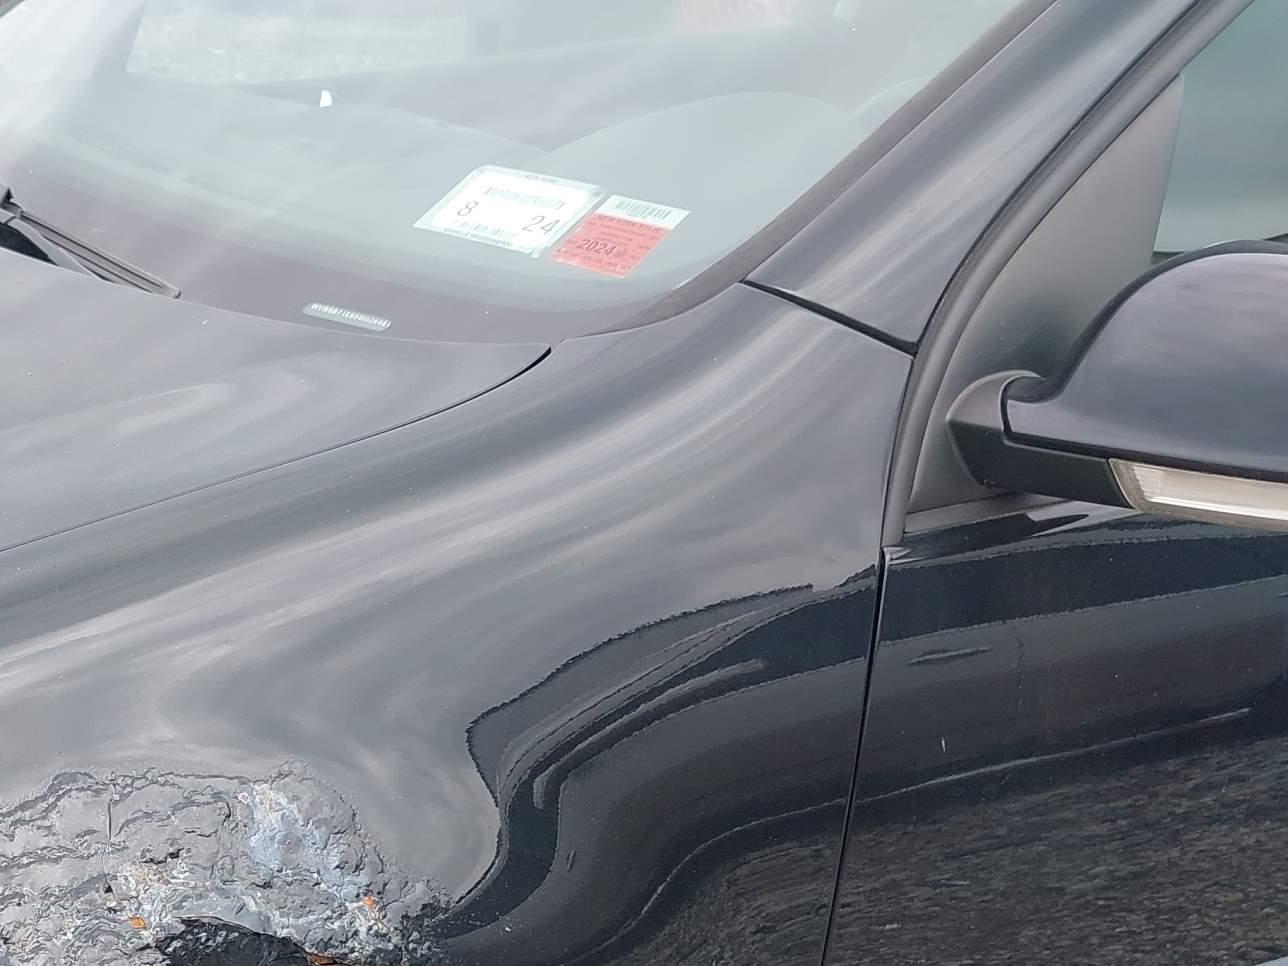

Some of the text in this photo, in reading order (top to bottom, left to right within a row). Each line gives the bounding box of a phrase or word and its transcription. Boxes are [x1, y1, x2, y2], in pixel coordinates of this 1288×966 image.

[456, 200, 561, 236] 8 24
[576, 239, 617, 256] 2024
